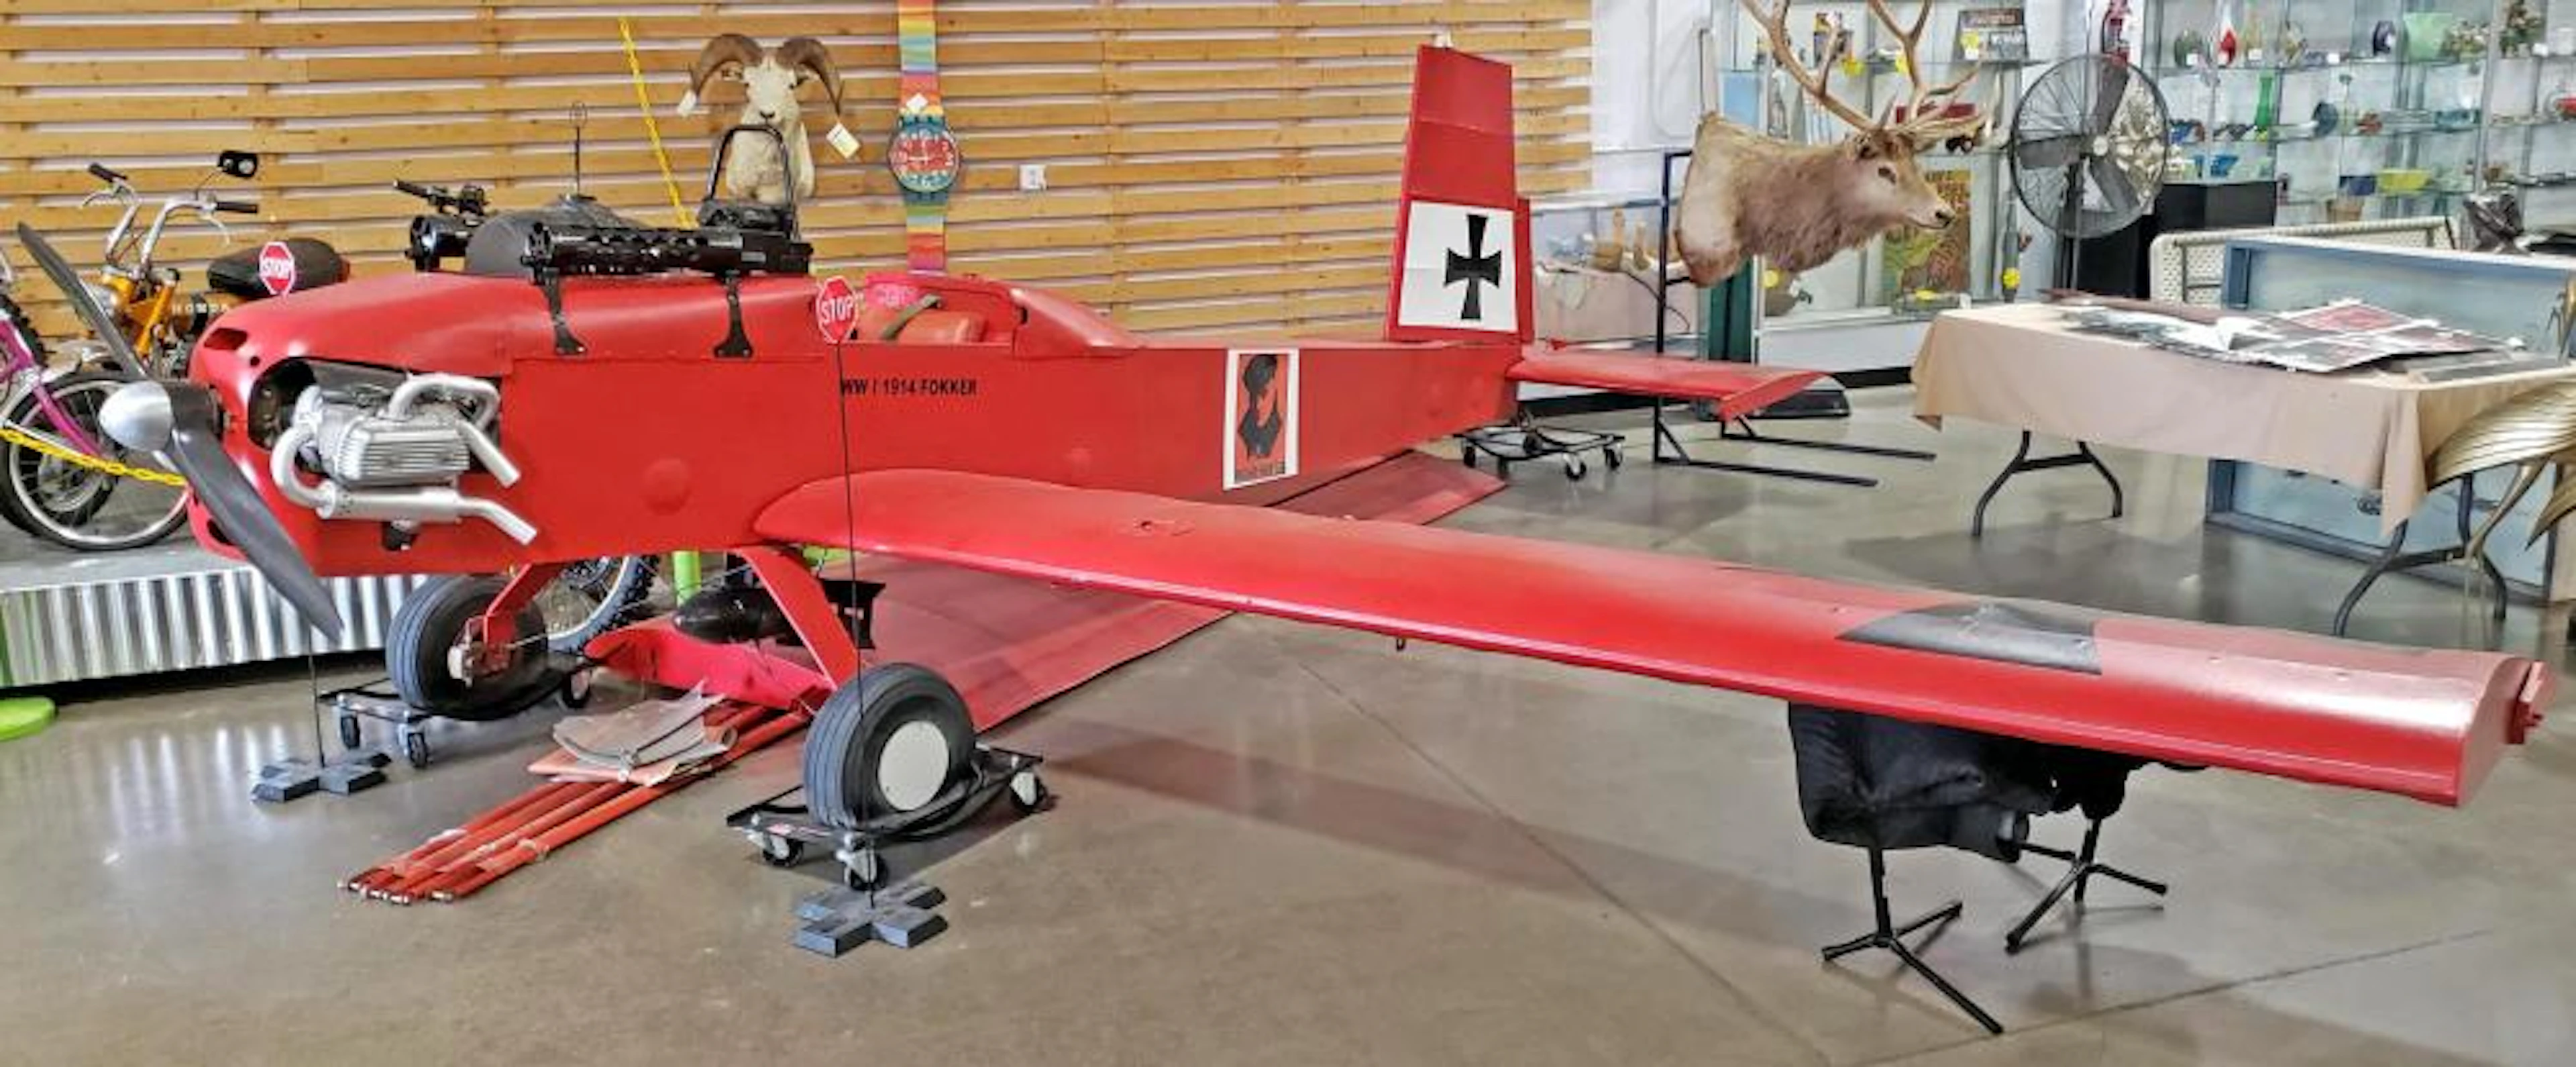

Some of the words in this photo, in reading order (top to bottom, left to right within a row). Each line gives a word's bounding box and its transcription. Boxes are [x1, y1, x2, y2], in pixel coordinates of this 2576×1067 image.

[261, 258, 290, 279] STOP
[821, 294, 853, 324] STOP
[843, 379, 867, 395] WW
[884, 379, 918, 395] 1914
[922, 378, 976, 395] FOKKER
